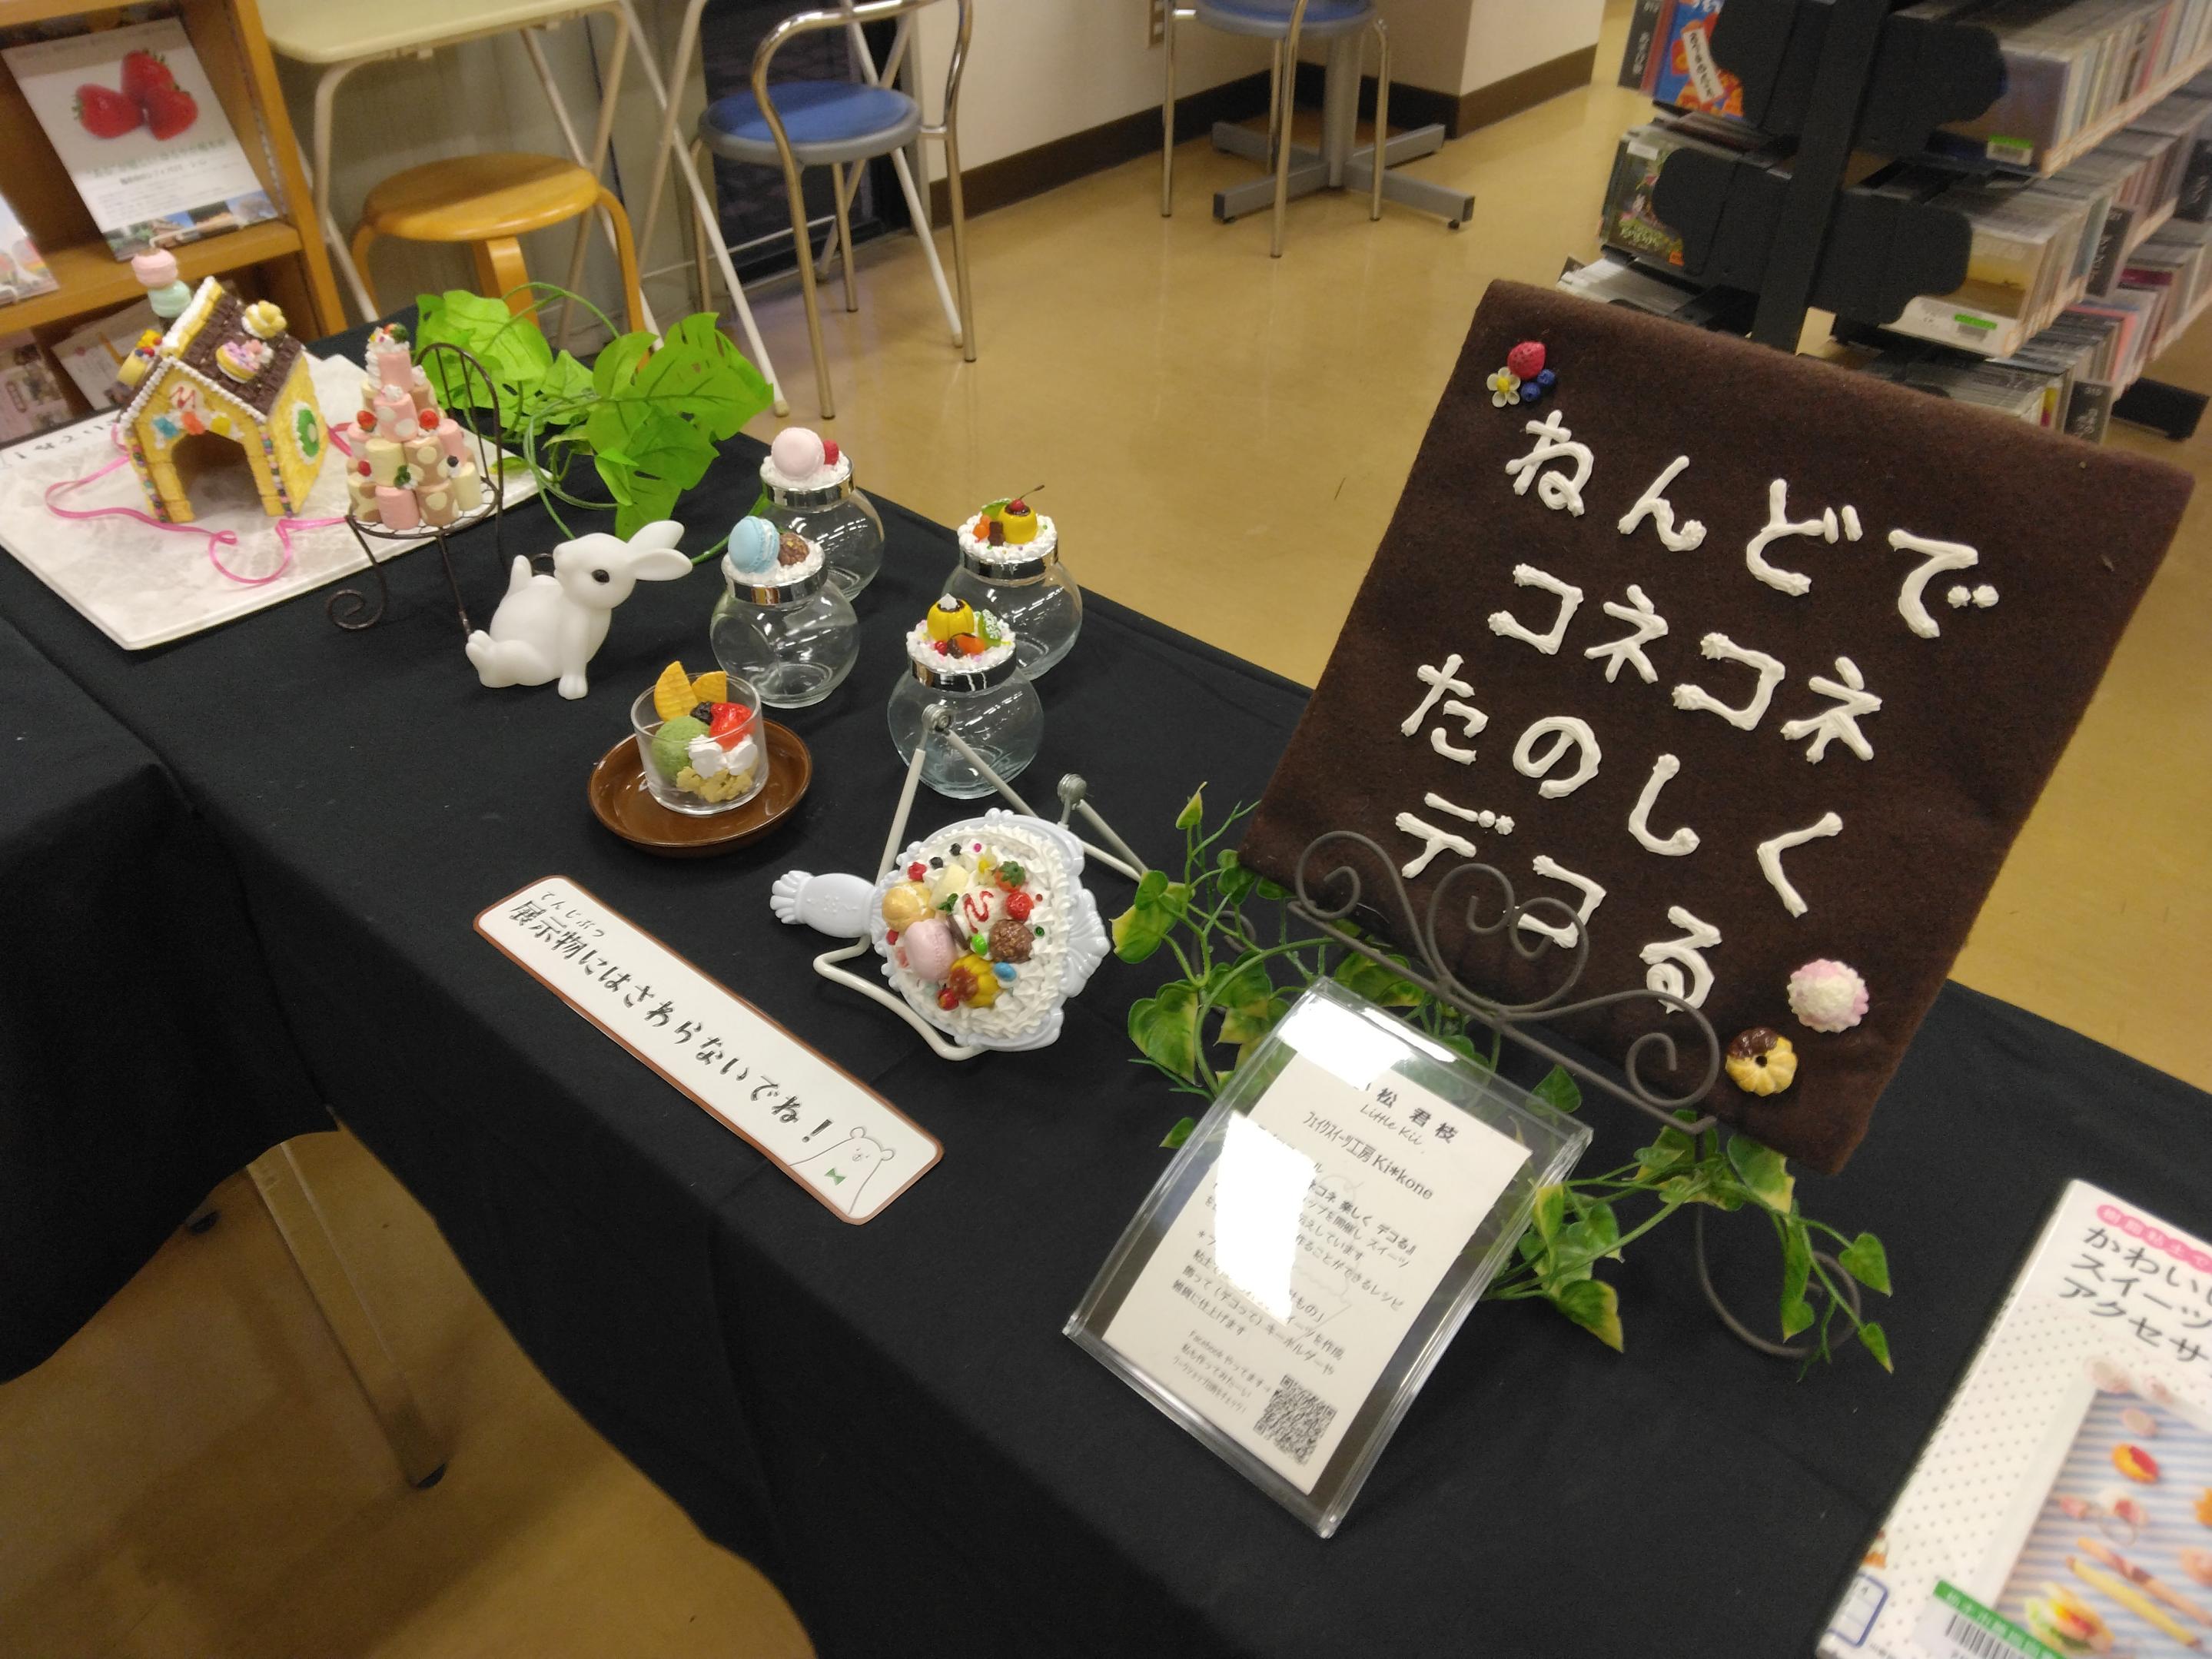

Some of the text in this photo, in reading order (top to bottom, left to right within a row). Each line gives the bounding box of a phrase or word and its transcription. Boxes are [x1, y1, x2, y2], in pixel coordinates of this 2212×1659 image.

[1505, 409, 1999, 639] ねんどで
[1487, 563, 1882, 763] コネコネ
[1400, 653, 1844, 919] たのしく
[1394, 792, 1723, 1014] デコる
[2058, 1277, 2212, 1378] アクセサ
